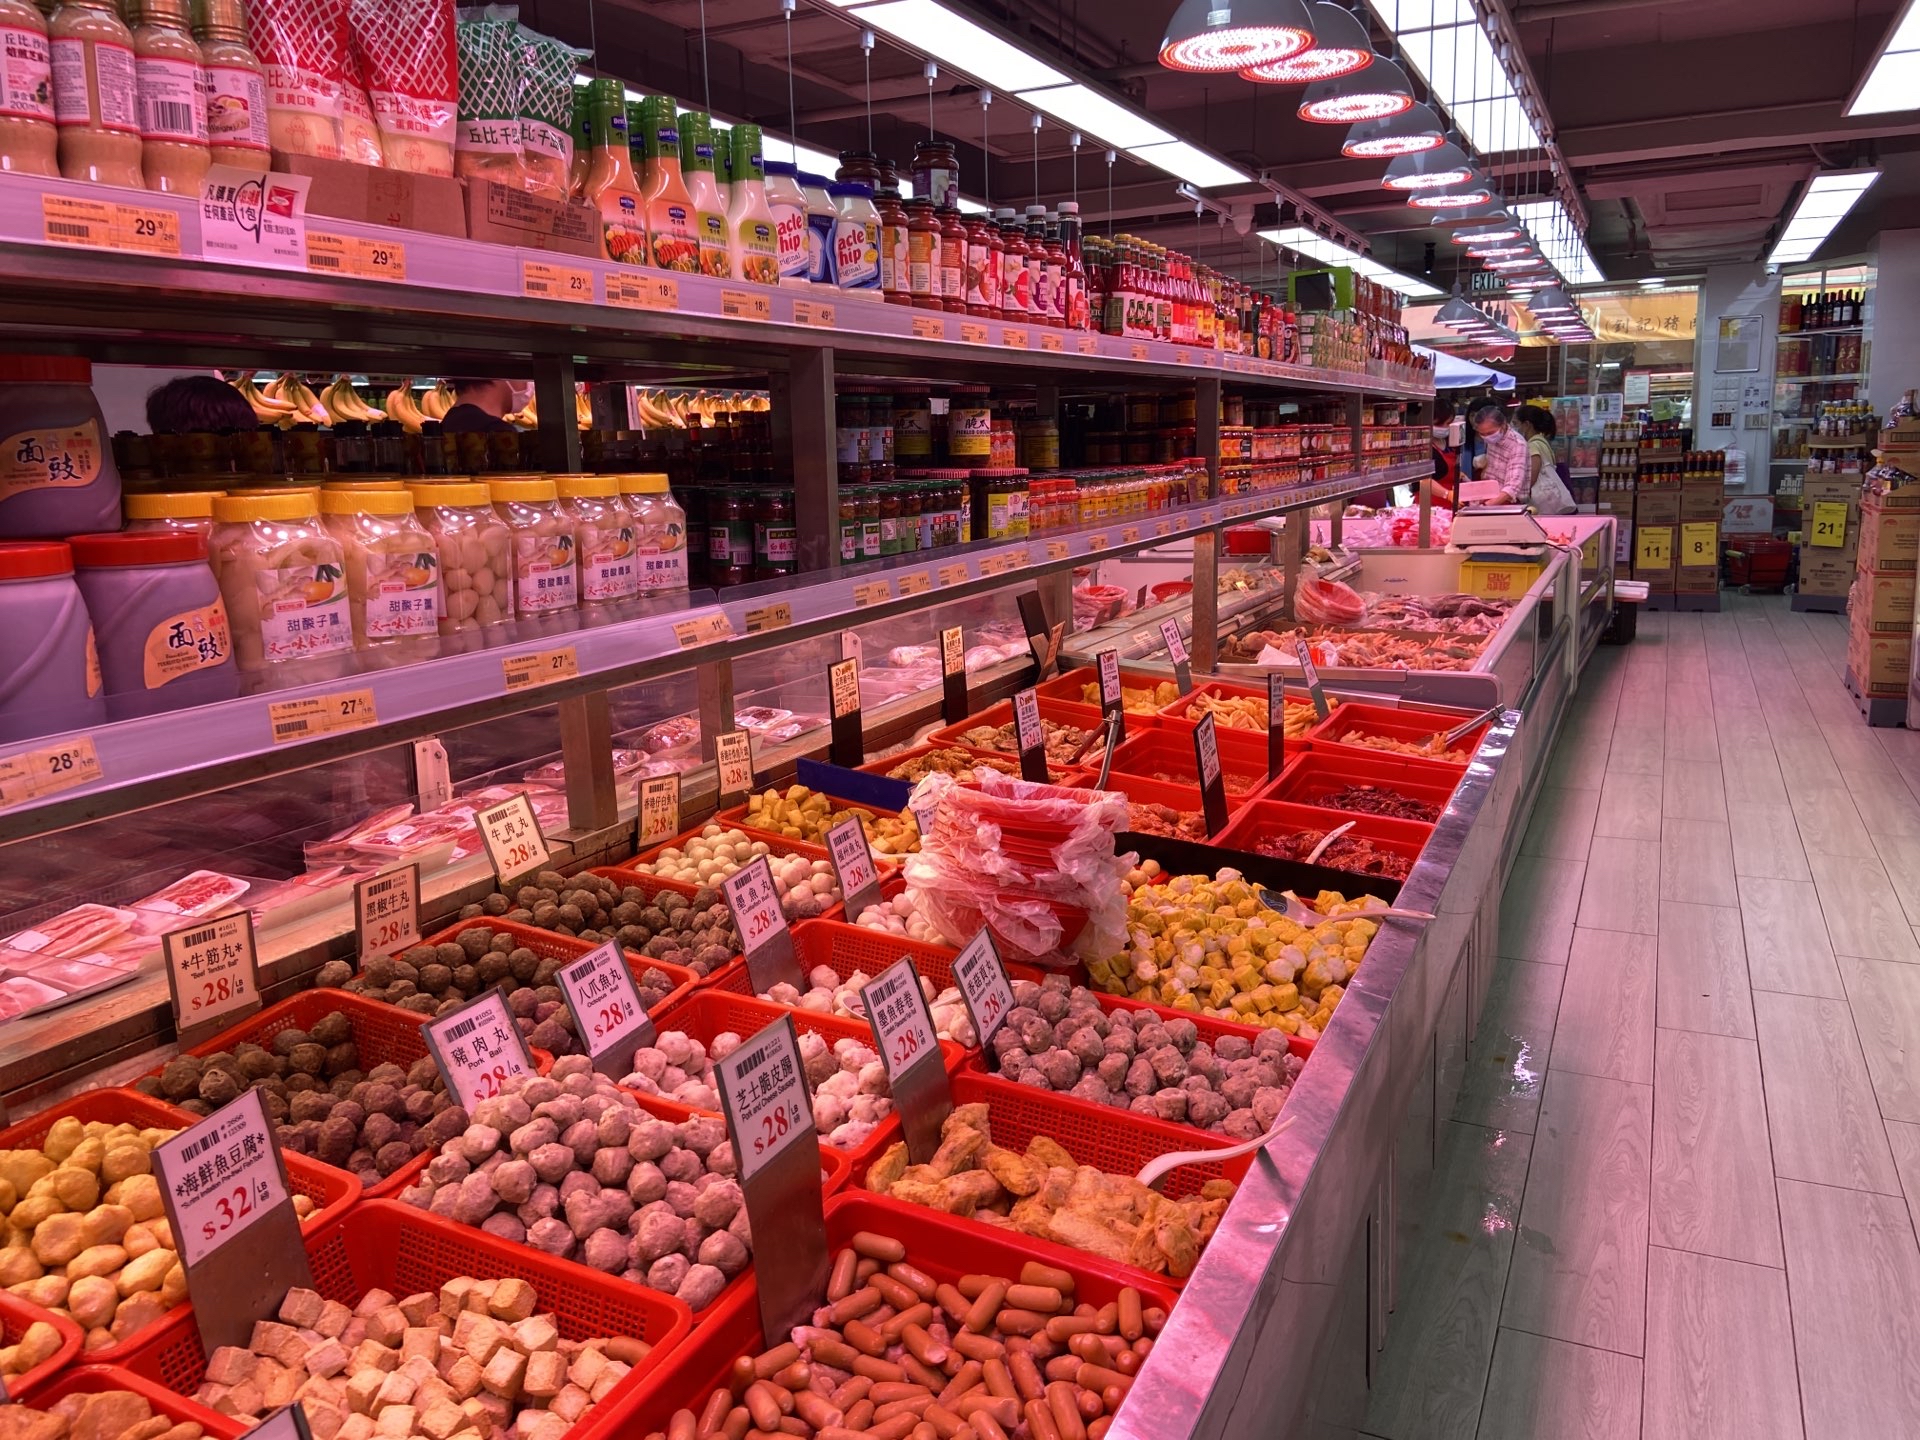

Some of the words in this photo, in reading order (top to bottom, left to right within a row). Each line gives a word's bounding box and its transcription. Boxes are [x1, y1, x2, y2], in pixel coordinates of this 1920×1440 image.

[276, 93, 316, 106] 蛋黃口味
[1474, 272, 1495, 290] EXIT
[17, 438, 82, 481] 面豉
[1818, 522, 1834, 534] 21
[1644, 546, 1660, 558] 11
[1694, 542, 1703, 553] 8
[389, 598, 432, 612] 甜酸子薑
[287, 612, 340, 633] 甜酸子薑
[169, 622, 222, 663] 面豉
[726, 768, 742, 785] $28
[491, 817, 528, 841] 牛肉丸
[647, 817, 667, 835] $28
[504, 844, 529, 869] $28
[847, 866, 864, 890] $28
[366, 890, 410, 918] 黑椒牛丸
[736, 879, 770, 910] 墨魚丸
[370, 921, 399, 950] $28
[749, 909, 770, 939] $28
[208, 964, 226, 974] Tendon
[968, 959, 994, 996] 香菇貢丸
[192, 977, 230, 1010] $28
[579, 968, 622, 1005] 八爪魚丸
[587, 993, 607, 1008] Octopus
[610, 985, 619, 993] Ball
[594, 1002, 624, 1037] $28
[877, 989, 914, 1030] 墨魚春卷
[983, 992, 1000, 1028] $28
[451, 1026, 509, 1067] 豬肉丸
[468, 1057, 485, 1070] Pork
[489, 1047, 503, 1058] Ball
[894, 1029, 917, 1066] $28
[736, 1054, 792, 1112] 芝士脆皮腸
[742, 1109, 752, 1122] Pork
[753, 1104, 761, 1115] and
[762, 1092, 778, 1110] Cheese
[778, 1077, 796, 1097] Sausage
[791, 1104, 798, 1114] LB
[753, 1106, 788, 1155] $28
[257, 1181, 268, 1193] LB
[202, 1186, 252, 1240] $32
